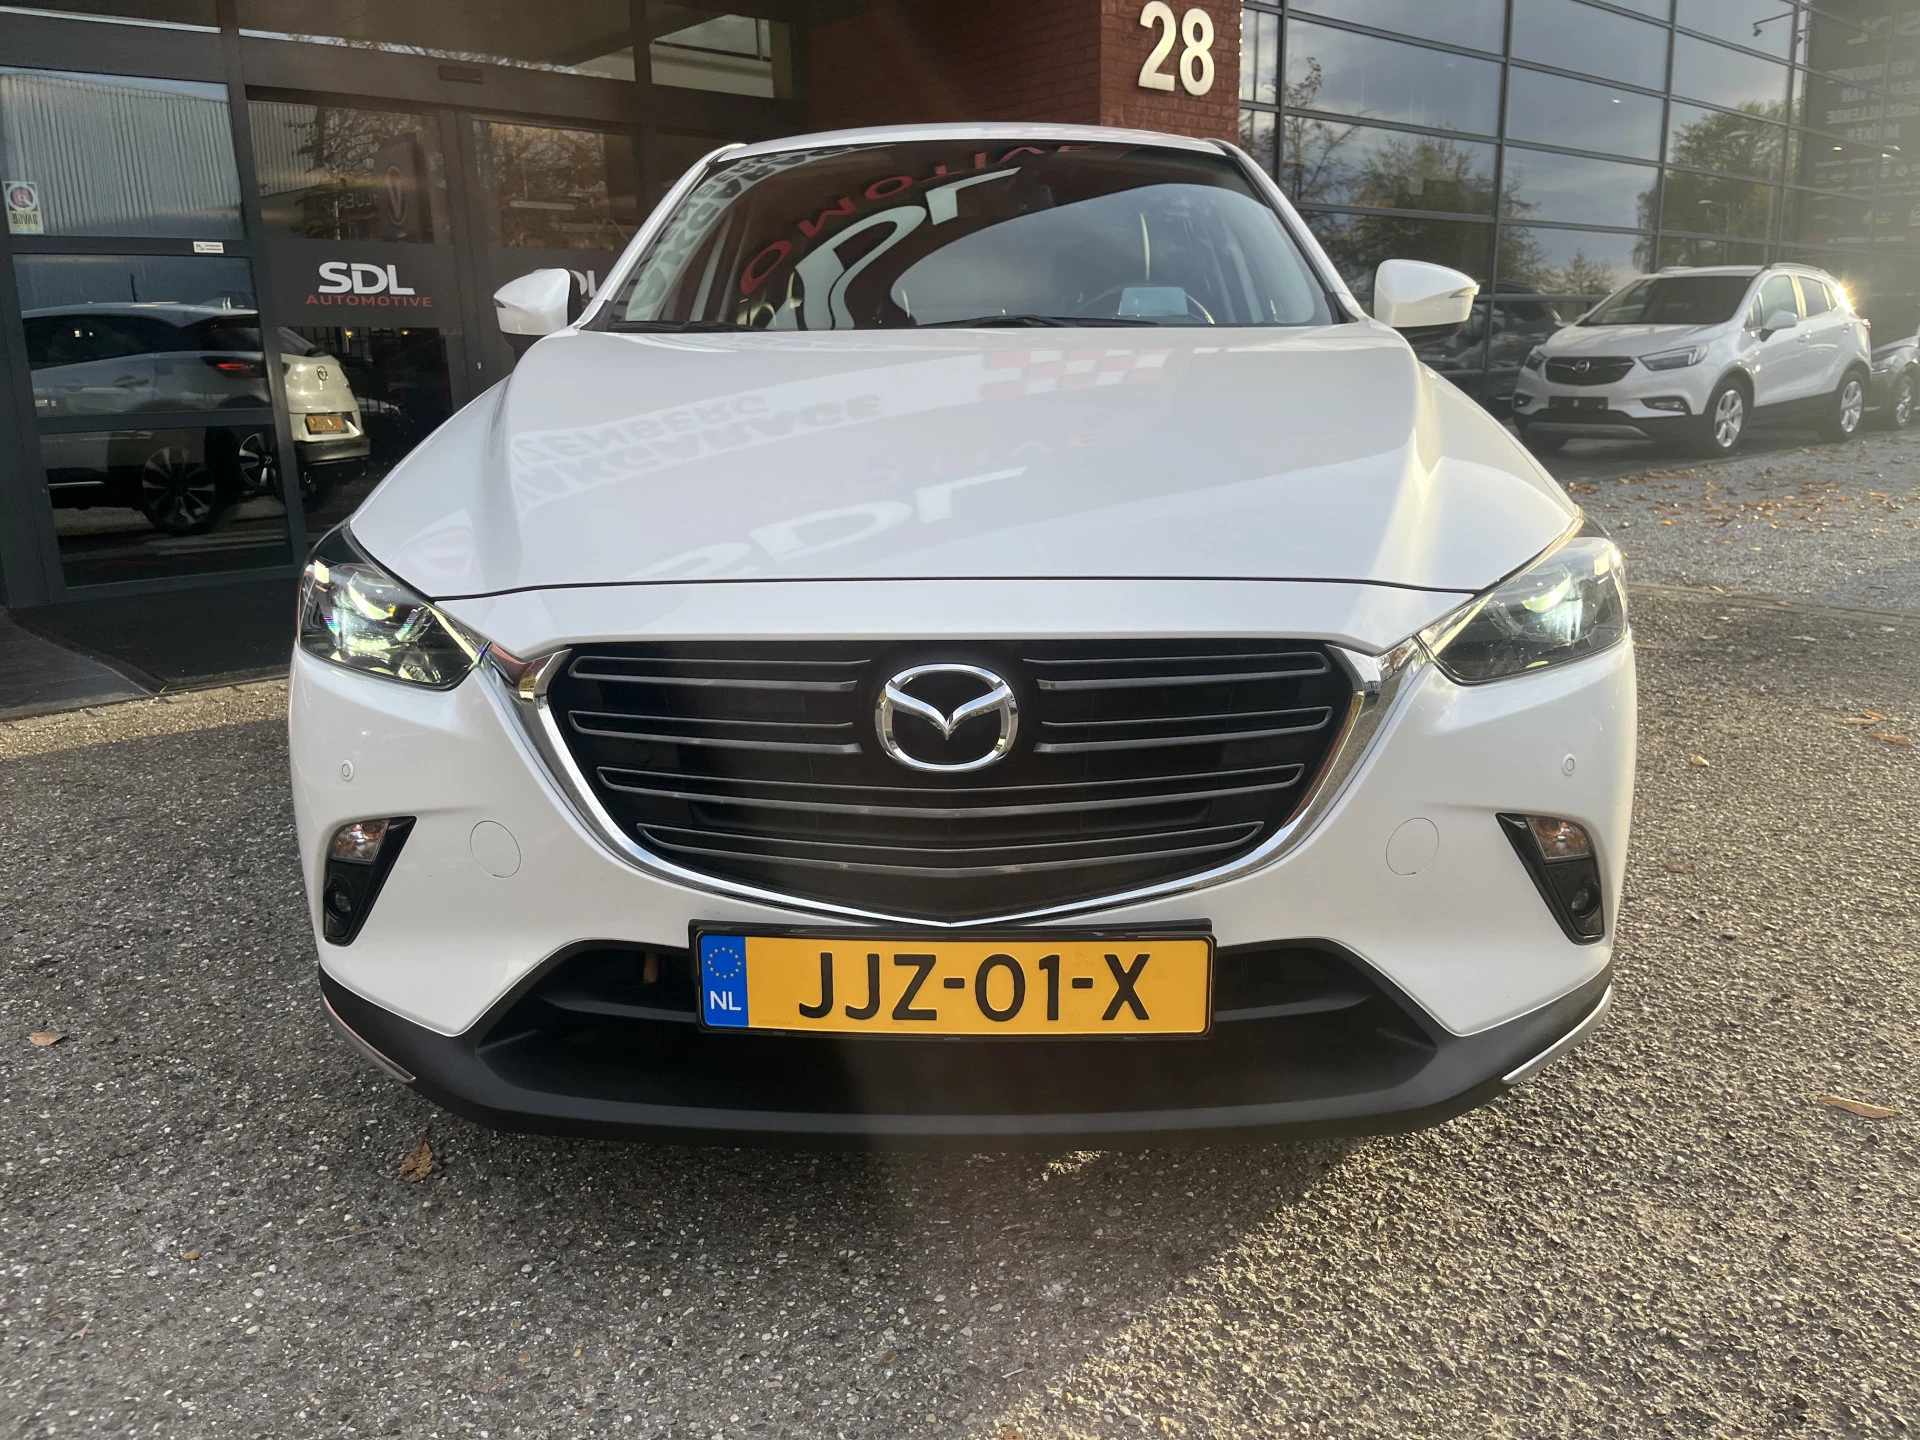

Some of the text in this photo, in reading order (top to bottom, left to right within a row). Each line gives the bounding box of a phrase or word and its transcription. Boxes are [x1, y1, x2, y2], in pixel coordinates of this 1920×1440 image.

[1138, 1, 1215, 96] 28
[306, 294, 432, 307] AUTOMOTIVE
[318, 261, 415, 295] SDL
[709, 951, 1151, 1022] NL JJZ-01-X
